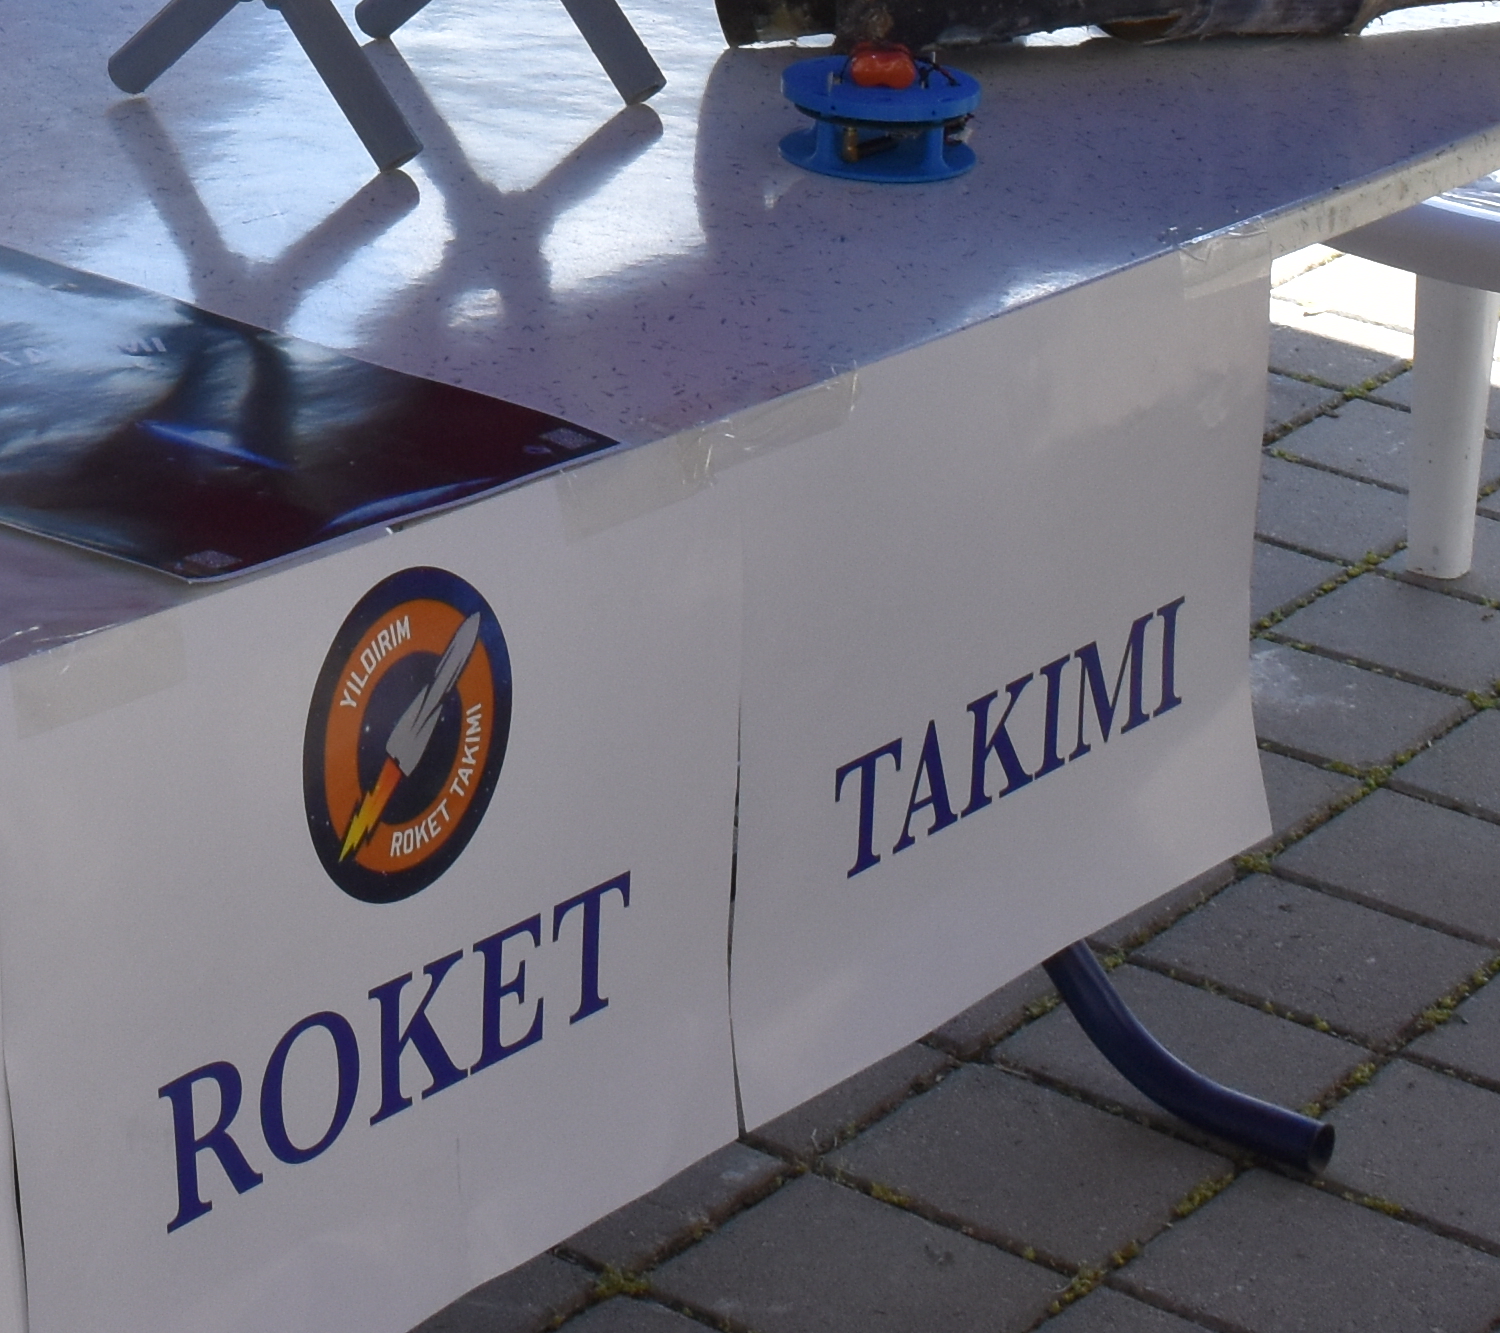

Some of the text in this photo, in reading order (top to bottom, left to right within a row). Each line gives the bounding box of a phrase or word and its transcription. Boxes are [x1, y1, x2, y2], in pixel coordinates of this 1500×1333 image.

[339, 614, 412, 710] YILDIRIM
[834, 594, 1186, 880] TAKIMI
[389, 703, 483, 858] ROKET TAKIMI
[157, 870, 632, 1235] ROKET
